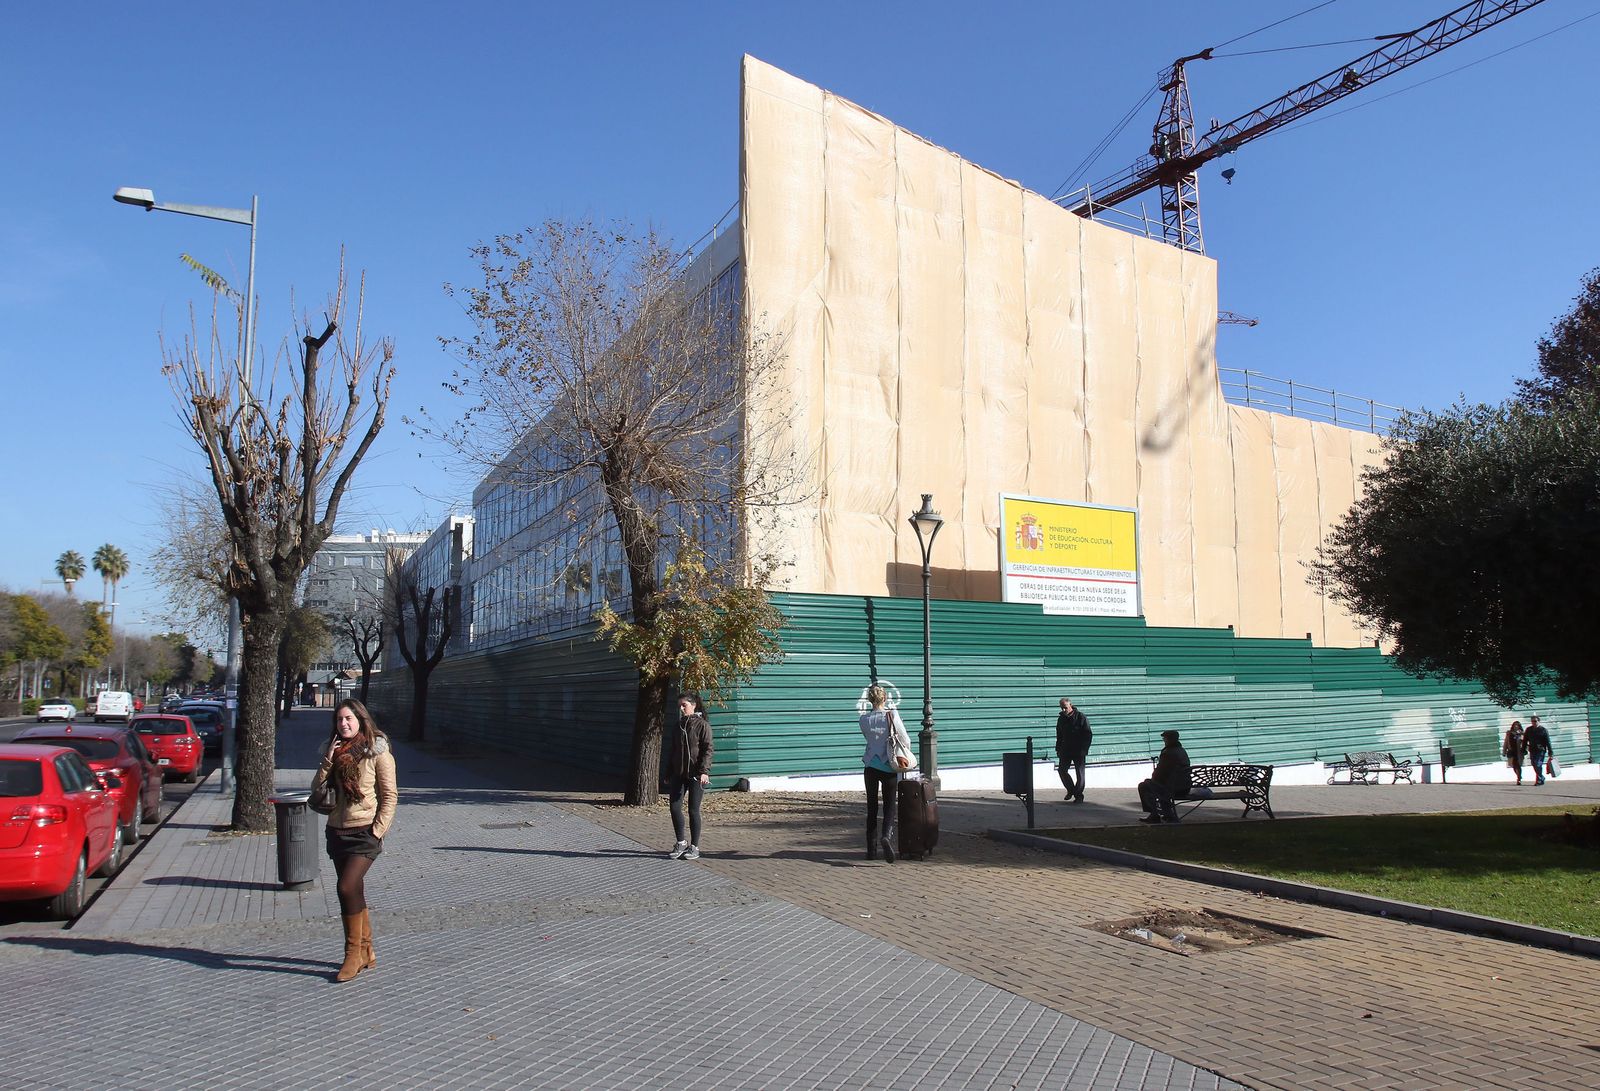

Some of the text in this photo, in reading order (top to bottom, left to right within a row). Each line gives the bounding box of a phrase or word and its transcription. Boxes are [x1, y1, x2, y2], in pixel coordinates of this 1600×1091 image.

[1049, 526, 1077, 534] MINISTERIO
[1012, 564, 1037, 572] GERENCIA
[1046, 566, 1093, 576] INFRAESTRUCTURAS
[1096, 569, 1132, 578] EQUIPAMIENTOS
[1019, 582, 1036, 590] OBRAS
[1020, 592, 1047, 600] BIBLIOTECA
